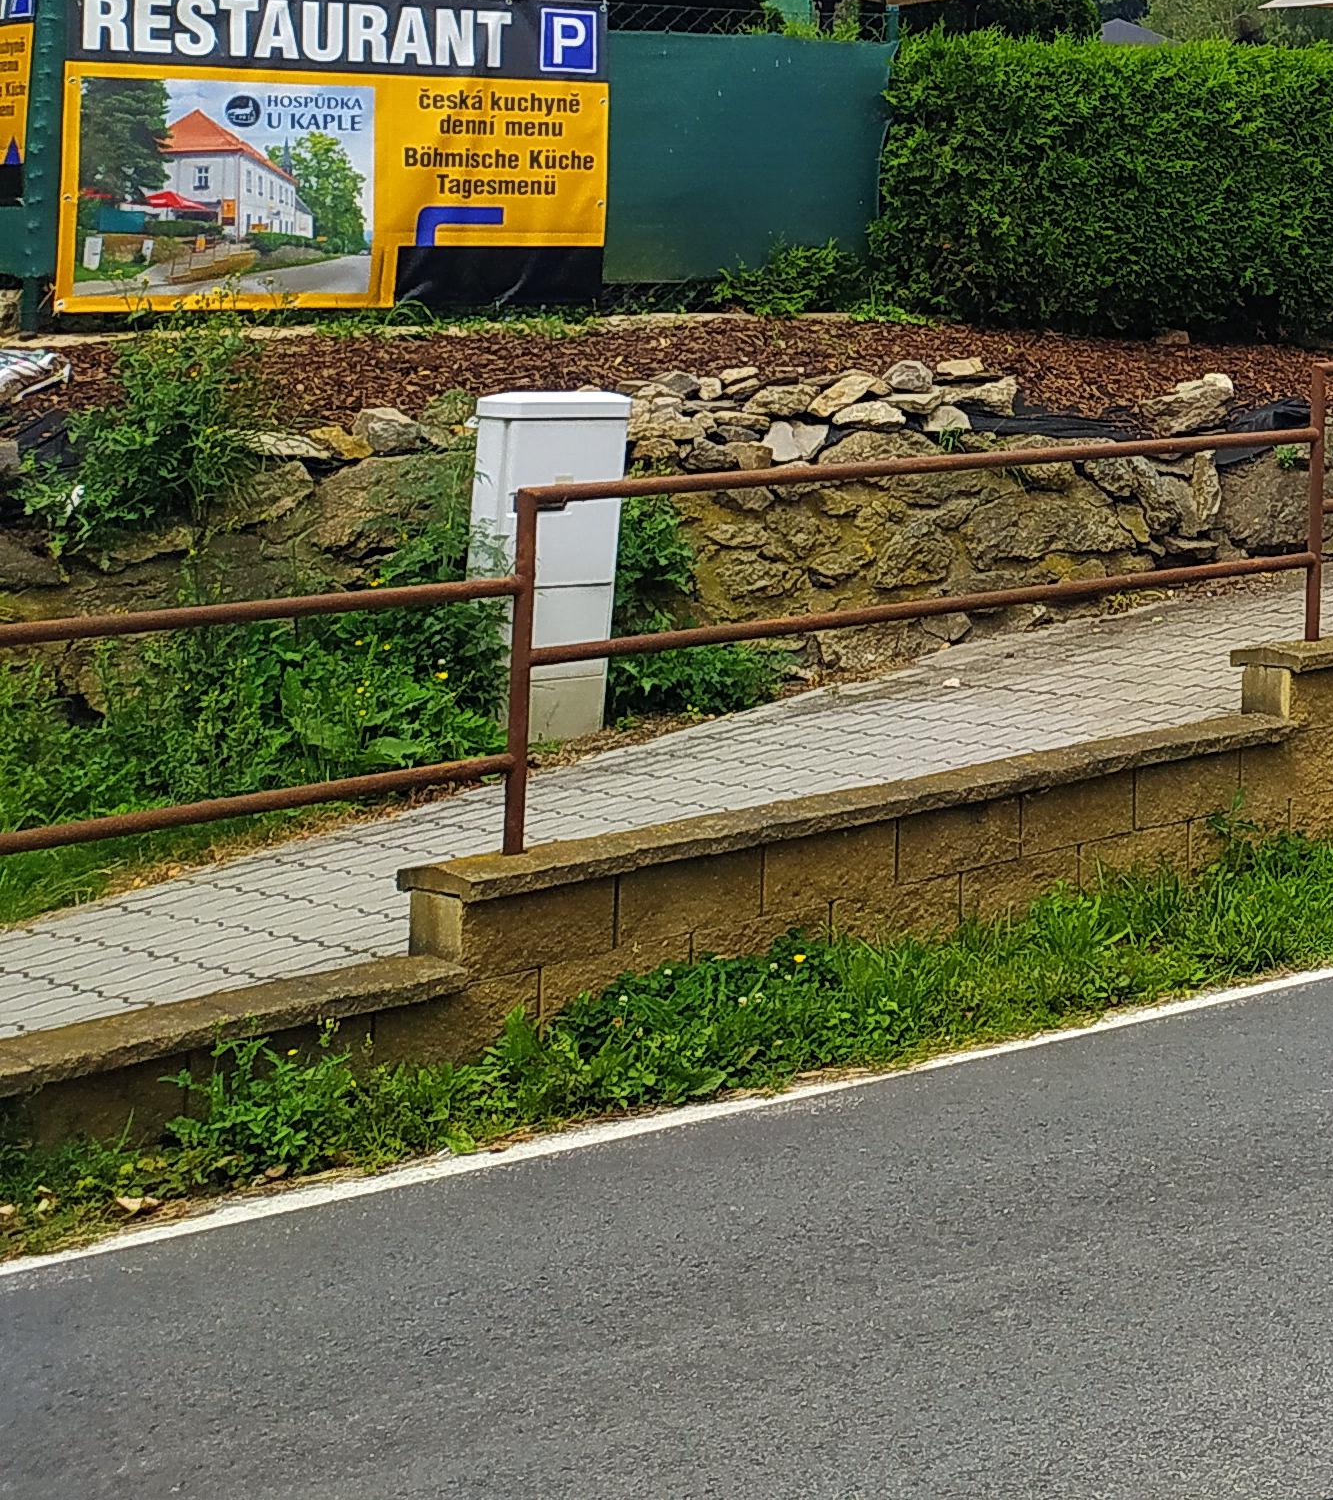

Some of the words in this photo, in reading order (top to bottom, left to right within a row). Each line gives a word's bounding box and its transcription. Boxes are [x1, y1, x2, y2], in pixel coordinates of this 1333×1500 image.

[552, 16, 587, 64] P
[267, 93, 363, 110] HOSPŮDKA
[418, 88, 483, 111] česká
[490, 91, 581, 117] kuchyně
[267, 113, 282, 129] U
[290, 113, 363, 131] KAPLE
[440, 114, 496, 135] denní
[505, 120, 563, 137] menu
[404, 146, 519, 169] Böhmische
[529, 149, 595, 170] Küche
[436, 174, 556, 199] Tagesmenü
